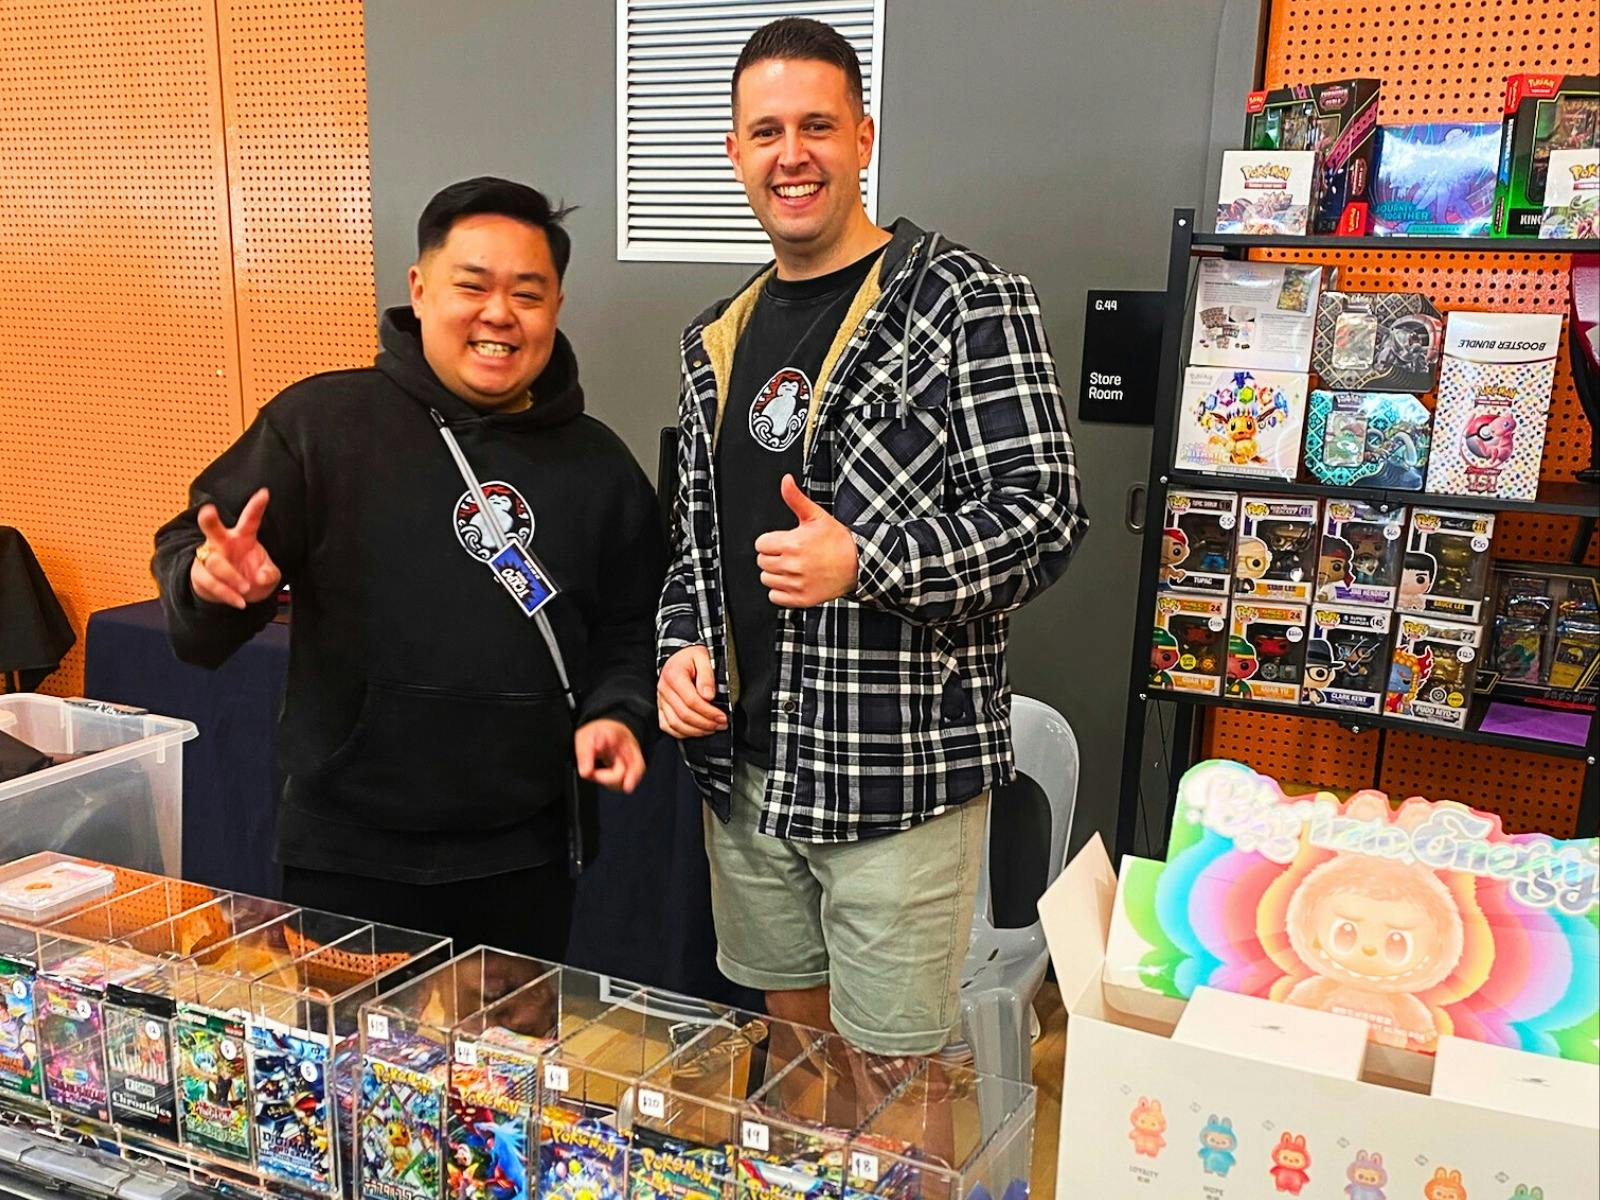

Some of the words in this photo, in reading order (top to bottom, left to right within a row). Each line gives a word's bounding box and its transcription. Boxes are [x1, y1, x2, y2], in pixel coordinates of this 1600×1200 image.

[1095, 299, 1118, 311] G.44
[1457, 339, 1497, 349] BUNDLE
[1497, 341, 1547, 351] BOOSTER
[1089, 371, 1122, 386] Store
[1088, 386, 1124, 401] Room
[1433, 600, 1453, 608] BRUCE
[1454, 602, 1466, 610] LEE
[1290, 611, 1301, 619] 24
[1331, 693, 1351, 701] CLARK
[1352, 695, 1367, 703] KENT
[112, 1091, 172, 1118] Chronicles
[1202, 1185, 1224, 1197] HOPE
